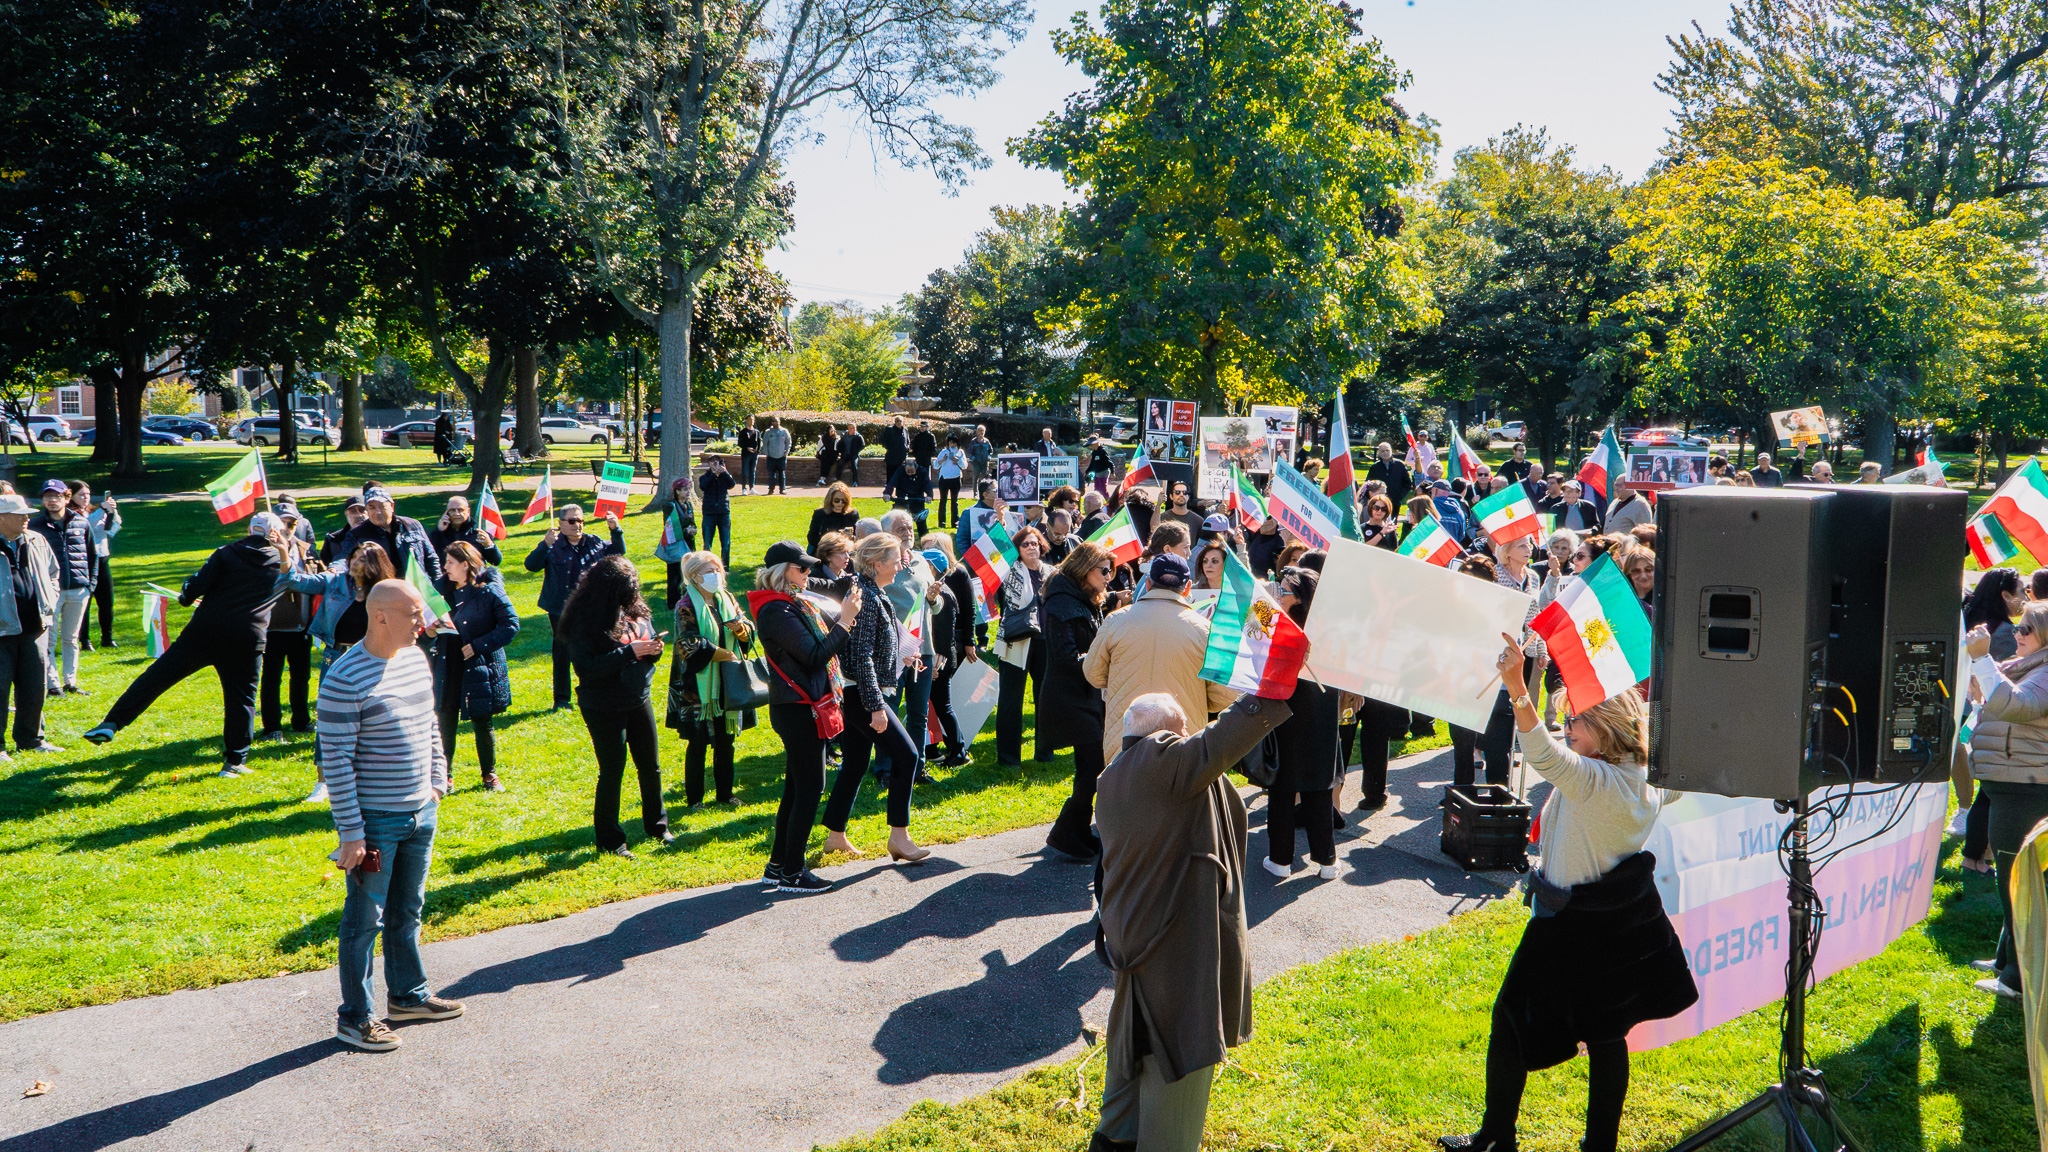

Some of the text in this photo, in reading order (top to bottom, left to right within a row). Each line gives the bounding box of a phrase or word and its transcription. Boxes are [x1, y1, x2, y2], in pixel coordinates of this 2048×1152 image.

[1054, 479, 1068, 487] IRAN
[1208, 477, 1230, 490] IRA
[1279, 464, 1341, 524] FREEDOM
[1300, 503, 1312, 520] FOR
[1281, 507, 1324, 549] IRAN
